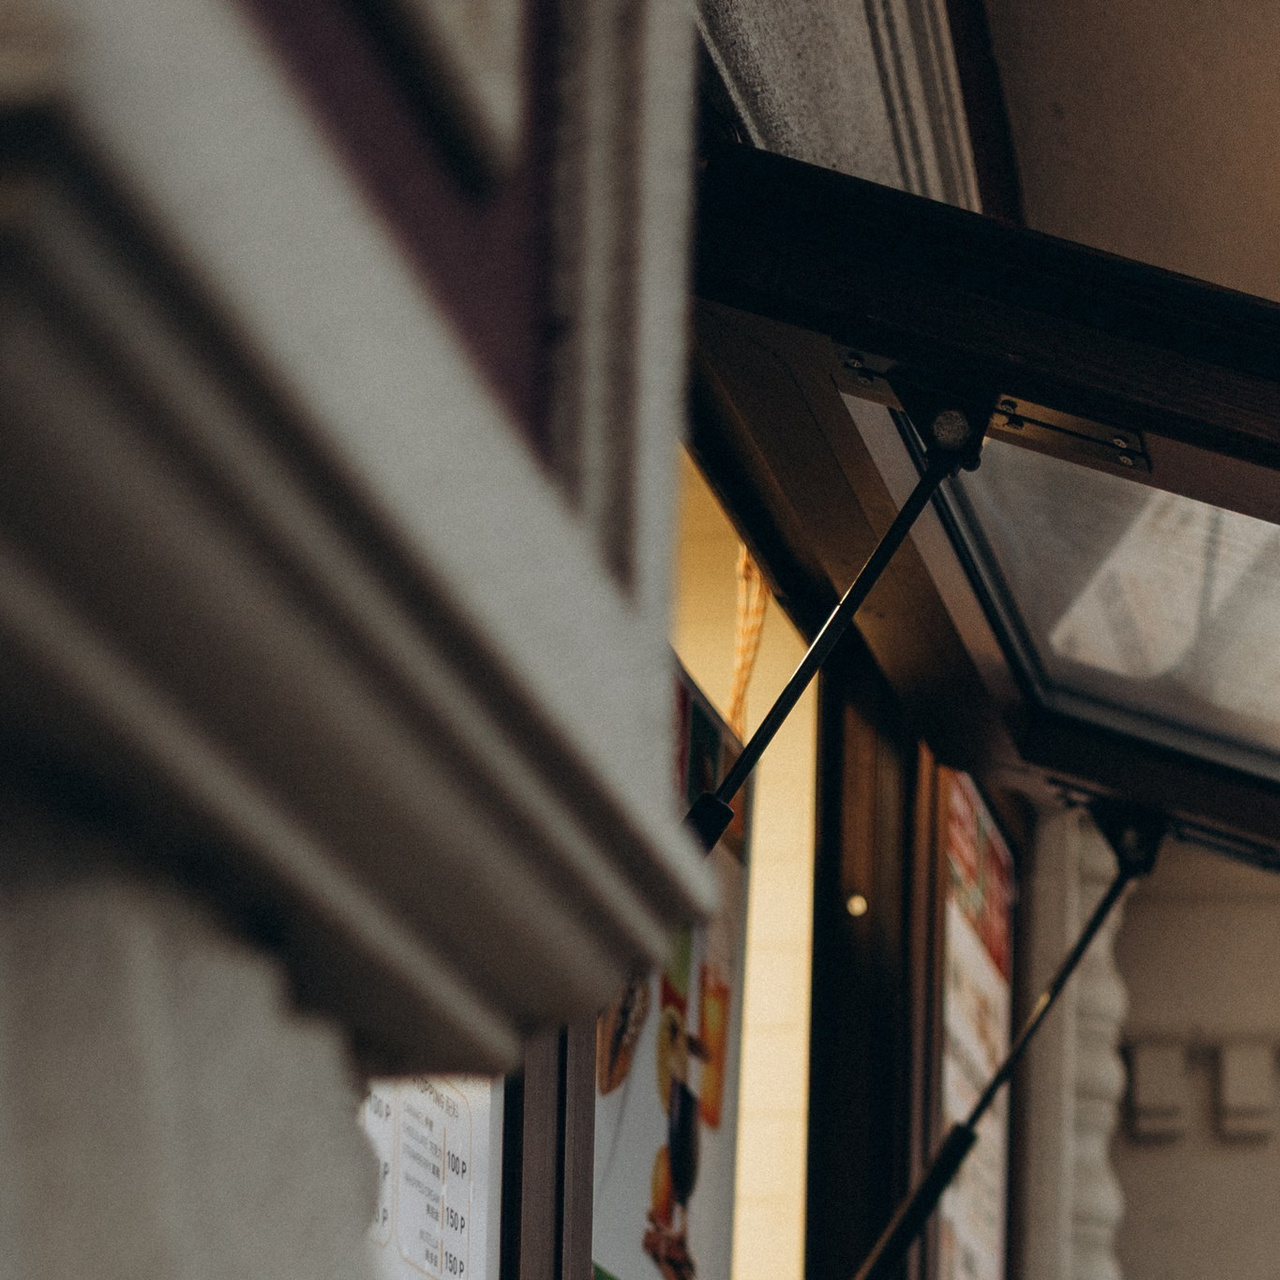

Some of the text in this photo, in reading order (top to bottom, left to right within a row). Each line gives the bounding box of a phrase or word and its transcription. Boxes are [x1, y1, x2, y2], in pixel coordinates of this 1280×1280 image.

[447, 1150, 460, 1175] 100
[446, 1206, 459, 1231] 150
[445, 1251, 458, 1275] 150
